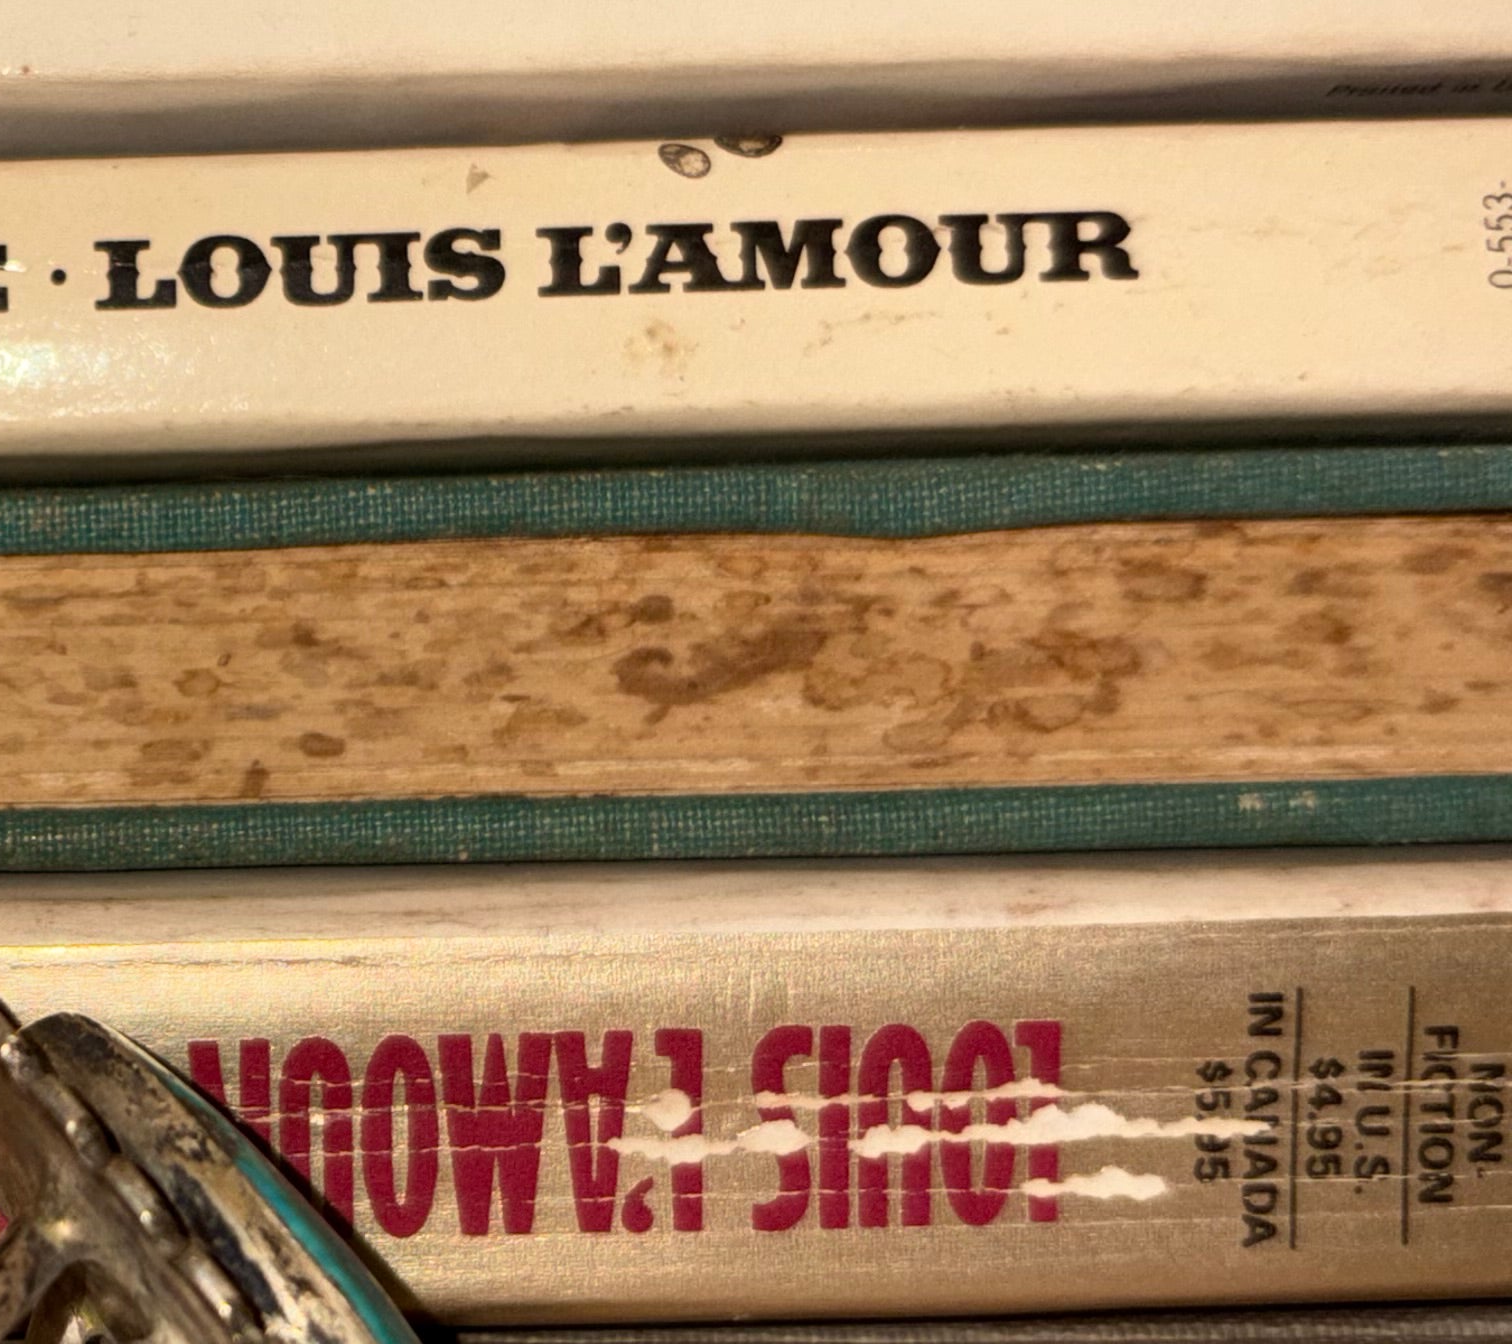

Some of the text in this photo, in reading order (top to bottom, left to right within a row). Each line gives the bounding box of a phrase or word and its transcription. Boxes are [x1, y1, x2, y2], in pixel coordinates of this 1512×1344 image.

[93, 227, 508, 311] LOUIS
[535, 210, 1141, 299] L'AMOUR
[1247, 992, 1285, 1037] IN
[750, 1020, 1063, 1232] LOUIS
[1305, 1057, 1346, 1180] $4.95
[1353, 1049, 1395, 1195] IN U.S.
[1417, 1024, 1460, 1205] FICTION
